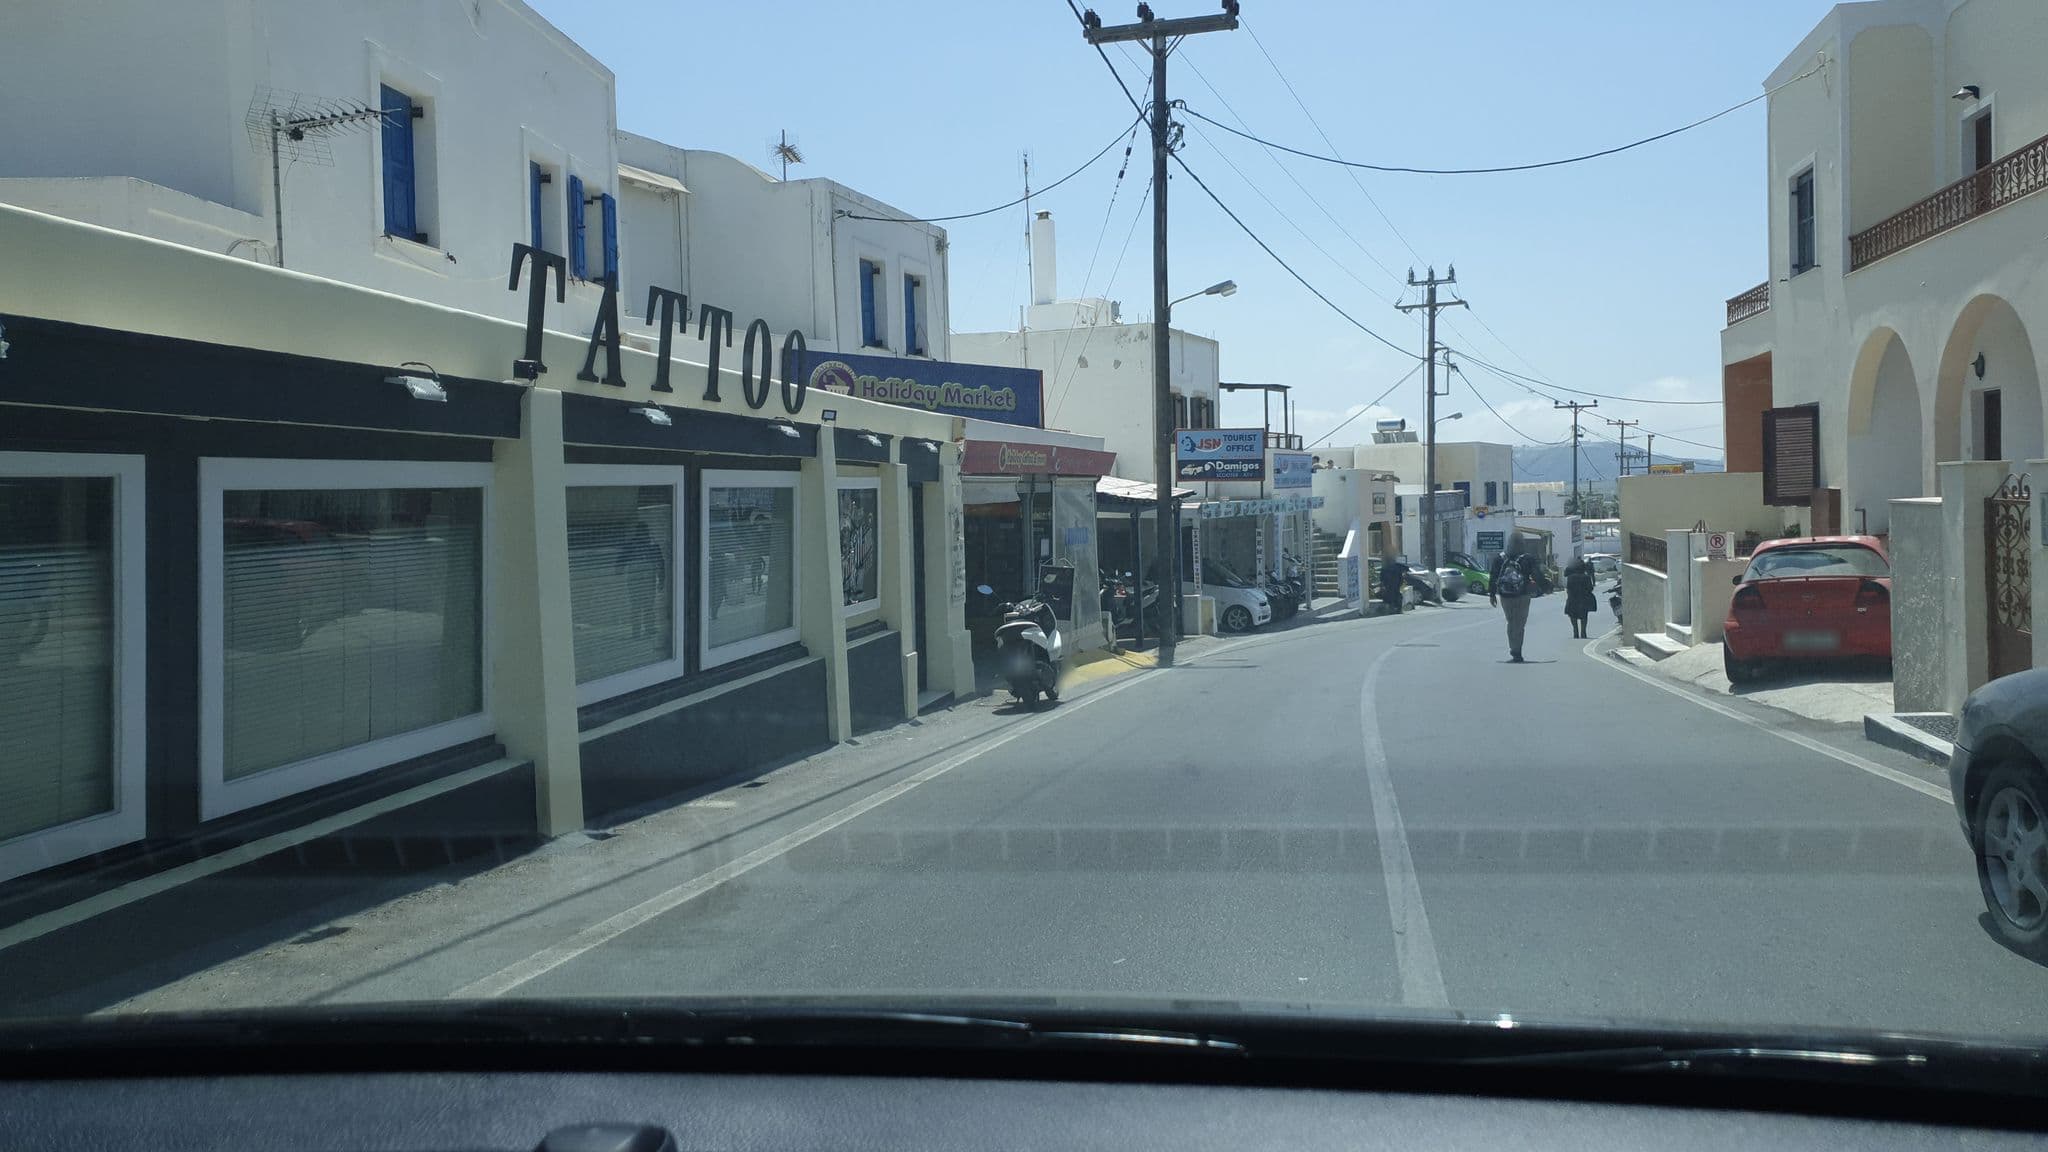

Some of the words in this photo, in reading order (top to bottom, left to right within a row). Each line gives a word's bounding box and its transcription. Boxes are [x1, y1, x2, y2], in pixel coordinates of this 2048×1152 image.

[508, 243, 807, 414] TATTOO
[861, 379, 937, 405] Holiday
[944, 386, 1014, 407] Market
[1223, 434, 1257, 442] TOURIST
[1226, 444, 1255, 452] OFFICE
[1216, 461, 1260, 472] Damigos
